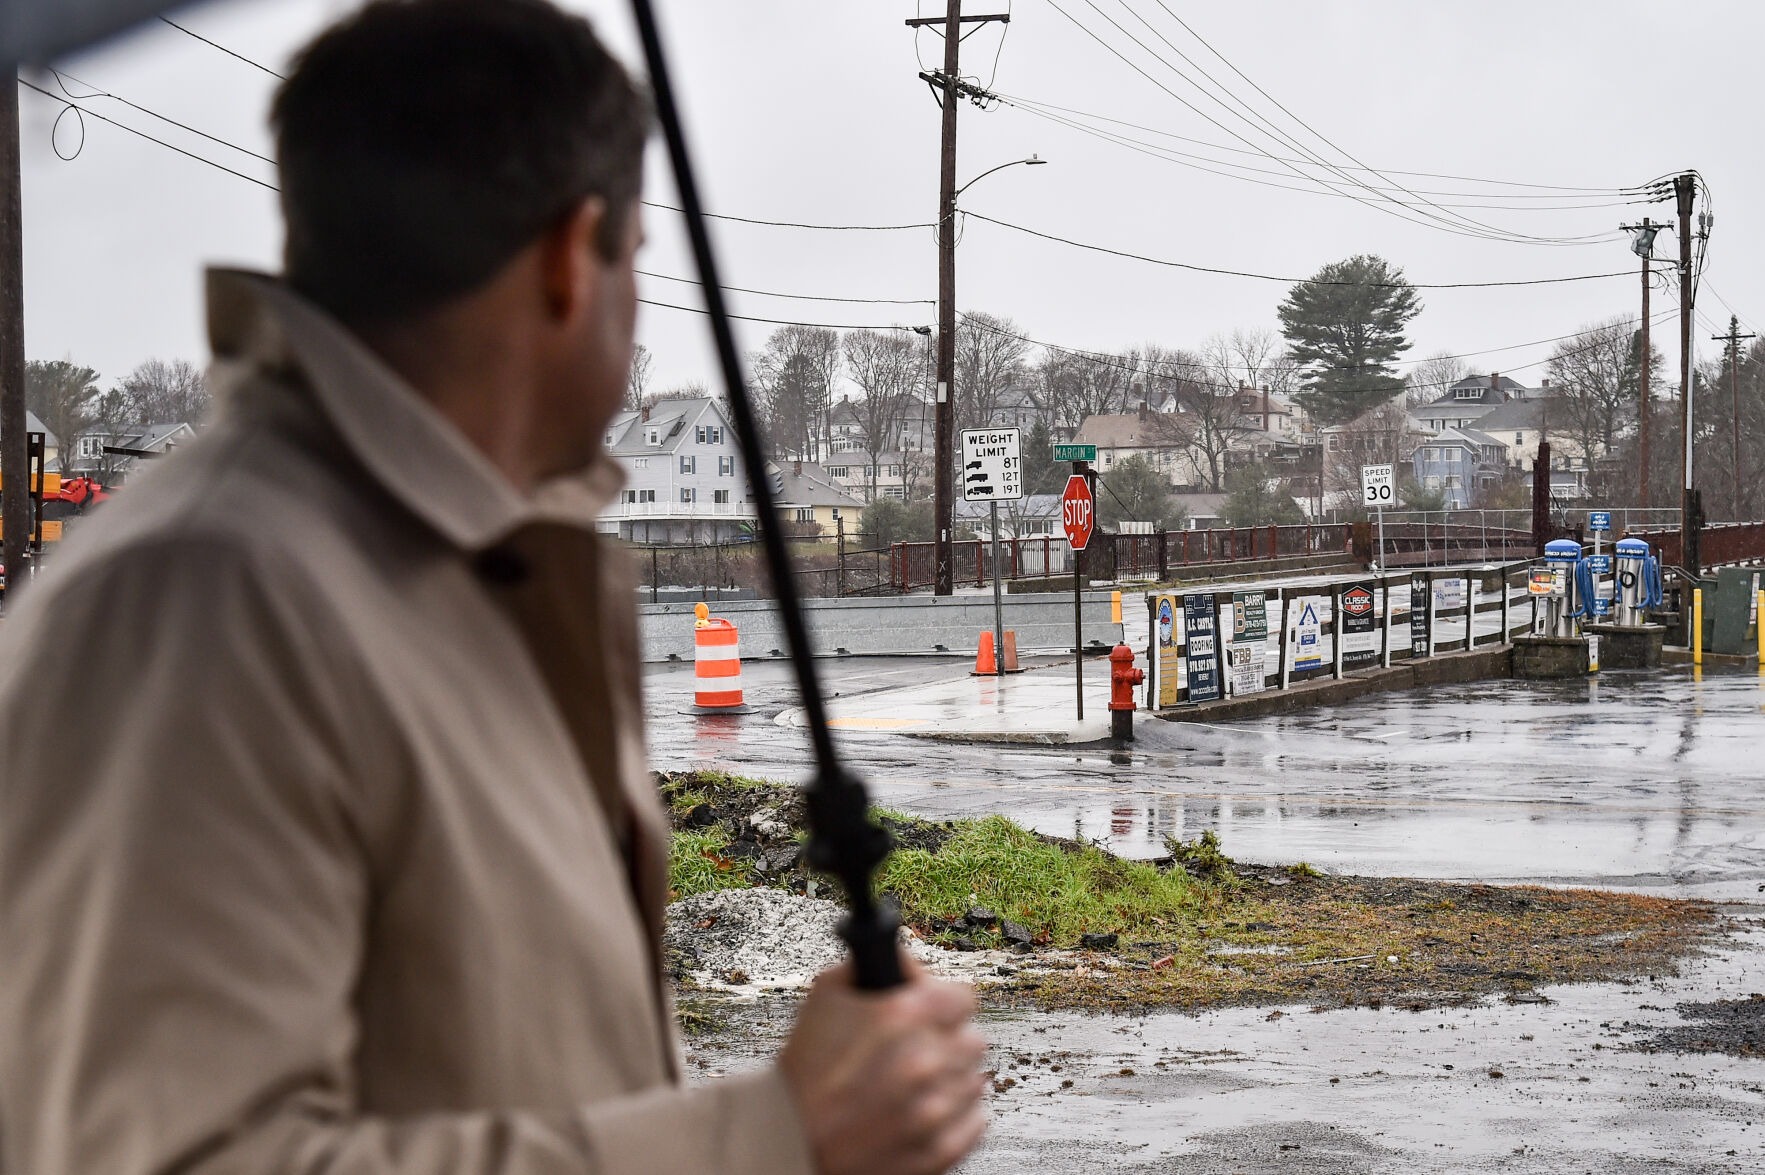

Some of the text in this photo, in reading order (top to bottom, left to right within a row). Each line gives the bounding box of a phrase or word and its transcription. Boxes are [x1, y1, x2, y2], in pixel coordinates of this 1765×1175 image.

[968, 434, 1013, 445] WEIGHT
[975, 447, 1006, 457] LIMIT
[1055, 446, 1086, 459] MARGIN
[1003, 457, 1019, 469] 8T
[1002, 472, 1018, 481] 12T
[1365, 468, 1390, 476] SPEED
[1003, 485, 1019, 494] 19T
[1367, 485, 1391, 500] 30
[1064, 499, 1091, 526] STOP
[1244, 595, 1264, 607] BARRY
[1344, 596, 1371, 605] CLASSIC
[1190, 639, 1213, 652] ROOFING
[1233, 647, 1252, 665] FBB
